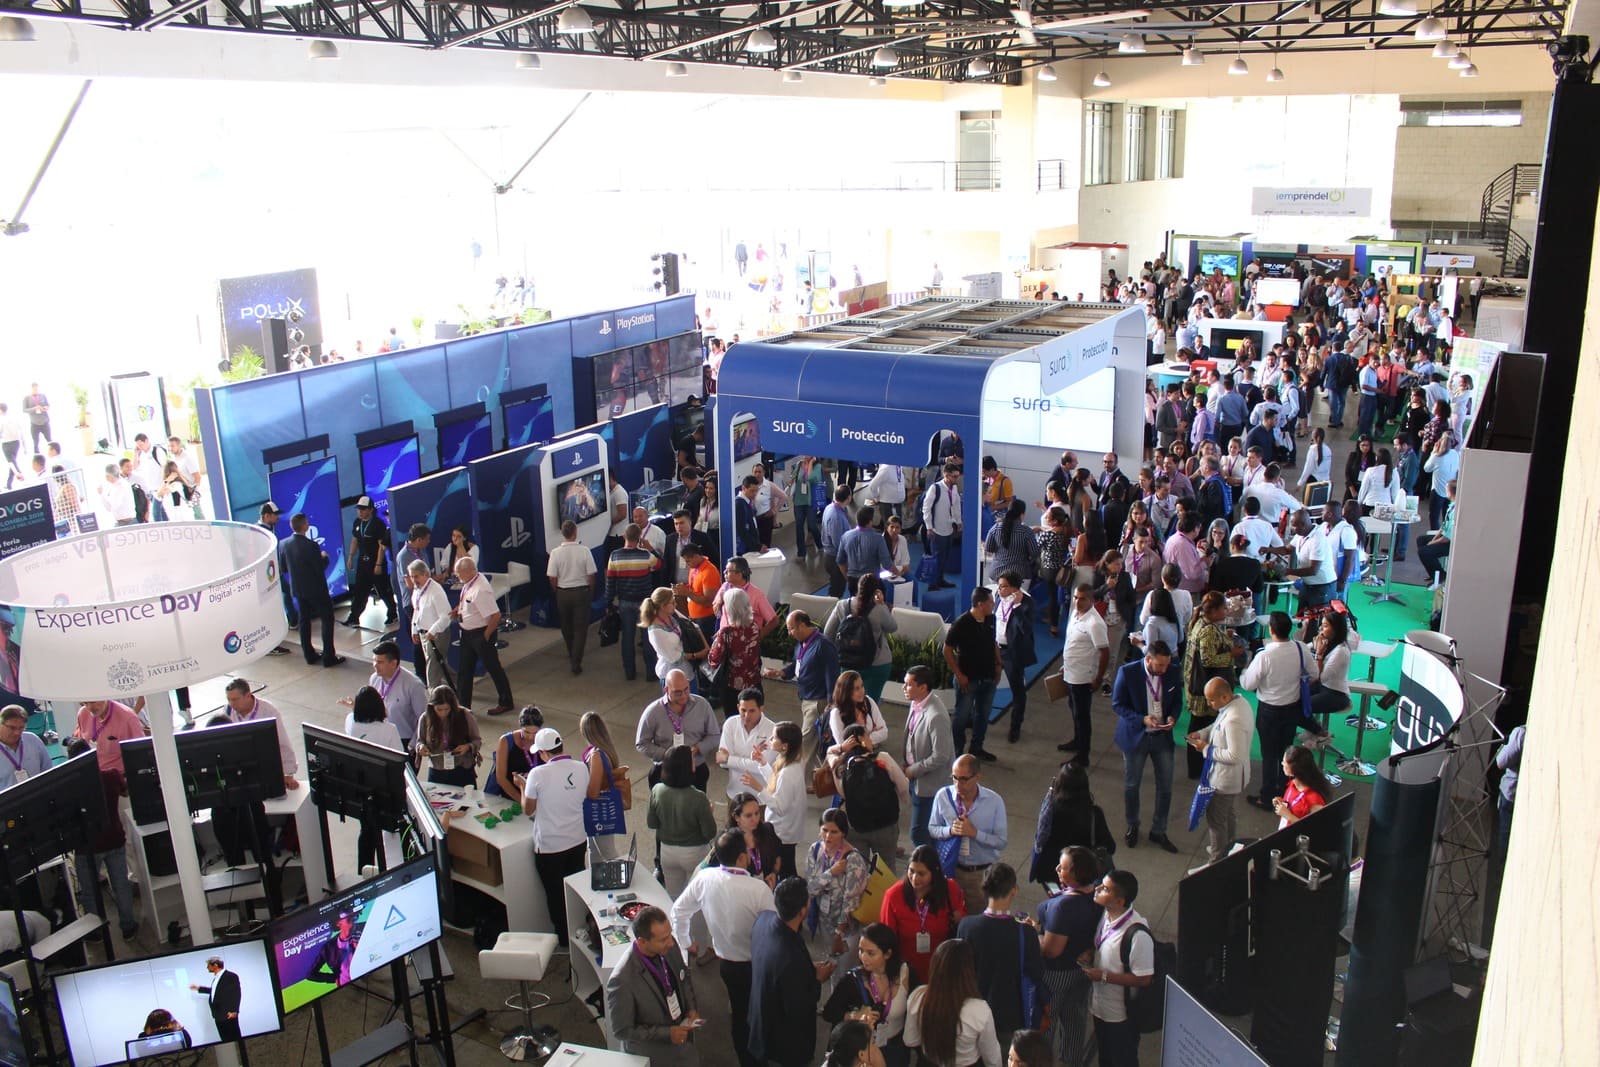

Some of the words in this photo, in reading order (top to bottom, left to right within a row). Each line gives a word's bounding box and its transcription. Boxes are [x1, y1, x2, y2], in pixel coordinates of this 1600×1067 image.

[240, 296, 307, 320] POLUX
[617, 313, 655, 331] PlayStation
[1049, 355, 1066, 377] sura
[1082, 339, 1108, 360] Protección
[1012, 397, 1051, 412] sura
[772, 420, 805, 434] sura
[841, 428, 905, 445] Protección
[1, 543, 31, 555] bebidas
[2, 538, 21, 547] feria
[209, 587, 232, 603] Digital
[237, 581, 251, 592] 2019
[34, 602, 155, 633] Experience
[159, 590, 202, 615] Day
[147, 659, 200, 678] JAVERIANA
[282, 922, 331, 950] Experience
[284, 941, 302, 958] Day
